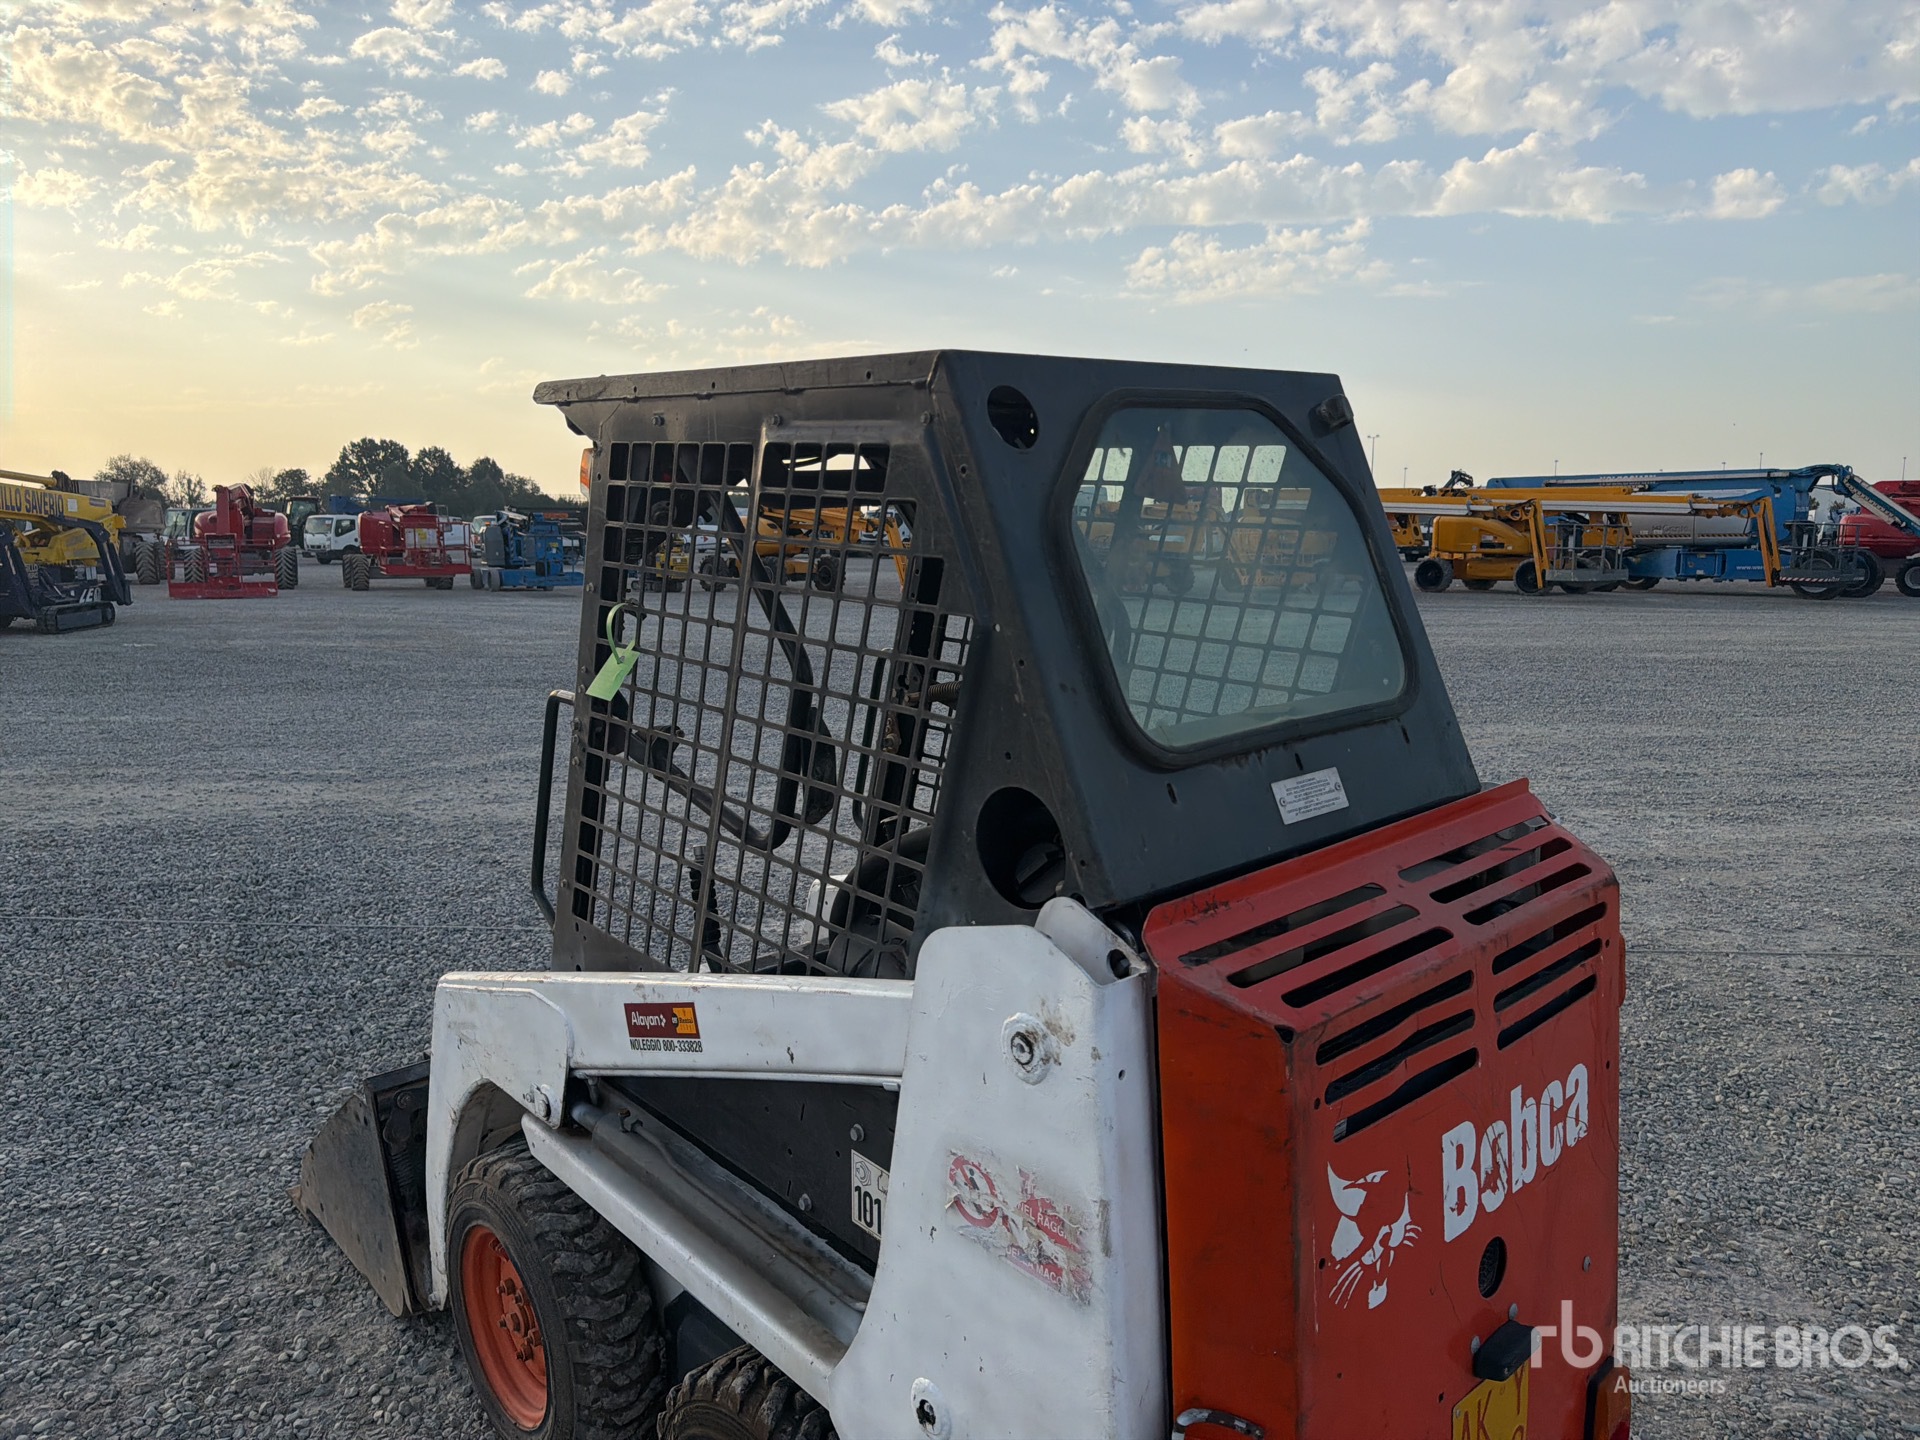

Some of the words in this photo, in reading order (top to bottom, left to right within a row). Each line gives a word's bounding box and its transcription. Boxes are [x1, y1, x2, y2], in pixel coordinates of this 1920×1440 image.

[25, 489, 64, 517] SAVERIO
[630, 1039, 661, 1051] NOLEGGIO
[1442, 1063, 1589, 1242] Bobca
[1038, 1212, 1068, 1239] RAGG
